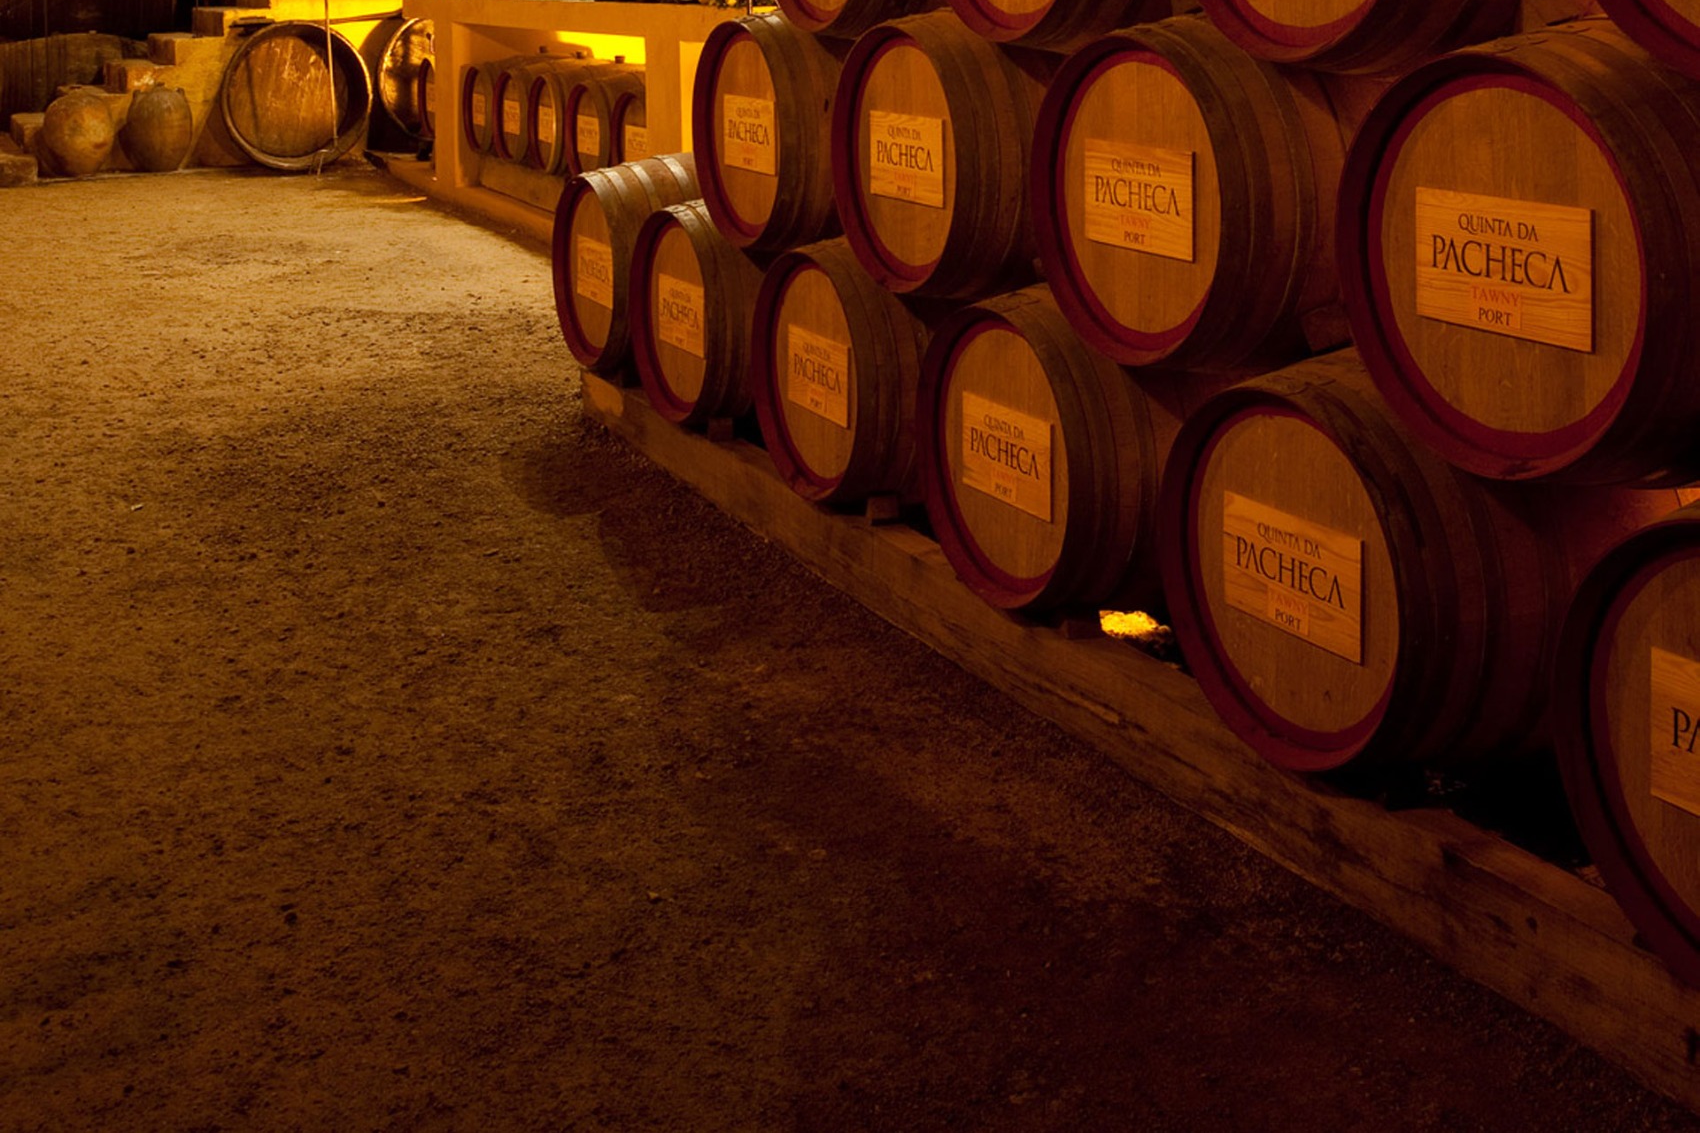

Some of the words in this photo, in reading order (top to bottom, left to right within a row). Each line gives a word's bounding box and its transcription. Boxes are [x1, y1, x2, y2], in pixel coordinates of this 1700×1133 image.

[728, 119, 770, 146] PACHECA
[876, 139, 934, 173] PACHECA
[1111, 158, 1146, 176] QUINTA
[1147, 163, 1162, 178] DA
[1095, 175, 1181, 217] PACHECA
[1124, 230, 1146, 245] PORT
[1458, 212, 1513, 238] QUINTA
[1517, 221, 1540, 242] DA
[1430, 233, 1573, 295] PACHECA
[1471, 285, 1521, 307] TAWNY
[1478, 307, 1513, 327] PORT
[794, 353, 841, 394] PACHECA
[983, 414, 1012, 438] QUINTA
[1013, 424, 1025, 440] DA
[970, 426, 1040, 480] PACHECA
[1257, 522, 1300, 551] QUINTA
[1304, 538, 1321, 559] DA
[1235, 535, 1345, 610] PACHECA
[1274, 607, 1301, 630] PORT
